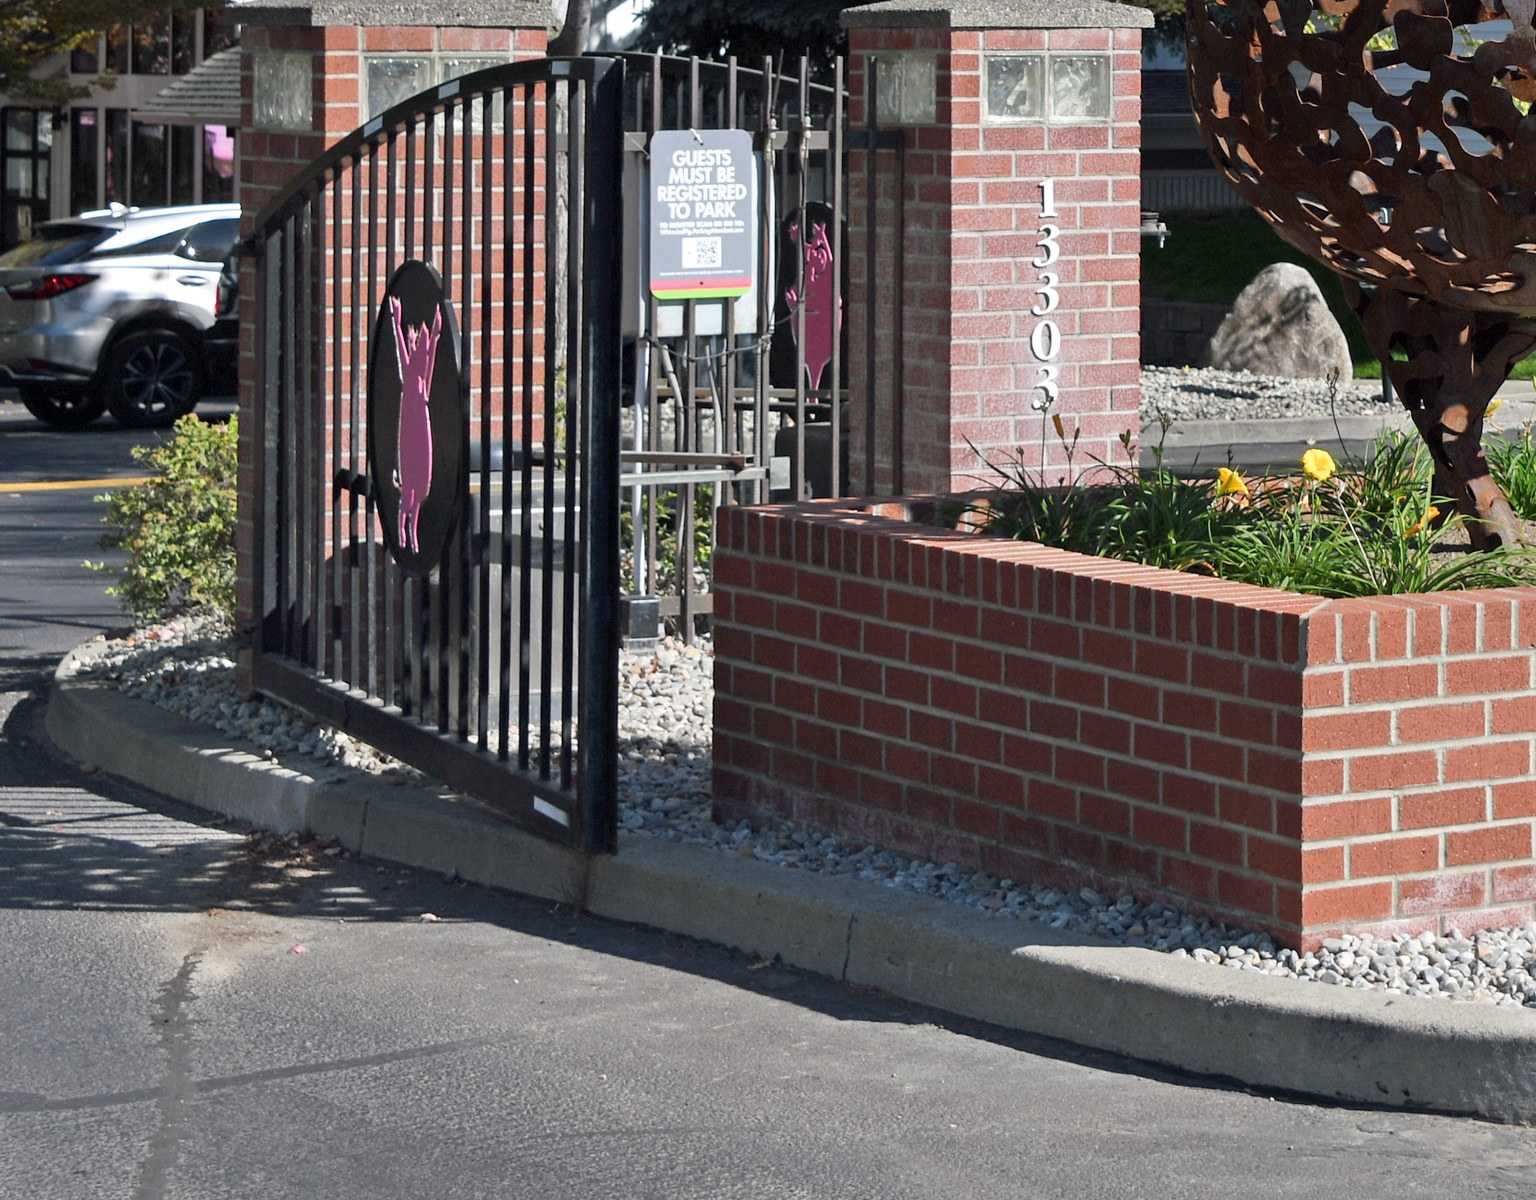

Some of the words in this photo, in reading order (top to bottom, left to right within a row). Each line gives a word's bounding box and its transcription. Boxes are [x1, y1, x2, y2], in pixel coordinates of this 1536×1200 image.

[672, 149, 732, 166] GUESTS
[668, 167, 713, 184] MUST
[717, 166, 736, 183] BE
[657, 184, 747, 202] REGISTERED
[668, 202, 690, 219] TO
[695, 201, 736, 218] PARK
[1031, 177, 1061, 410] 13303
